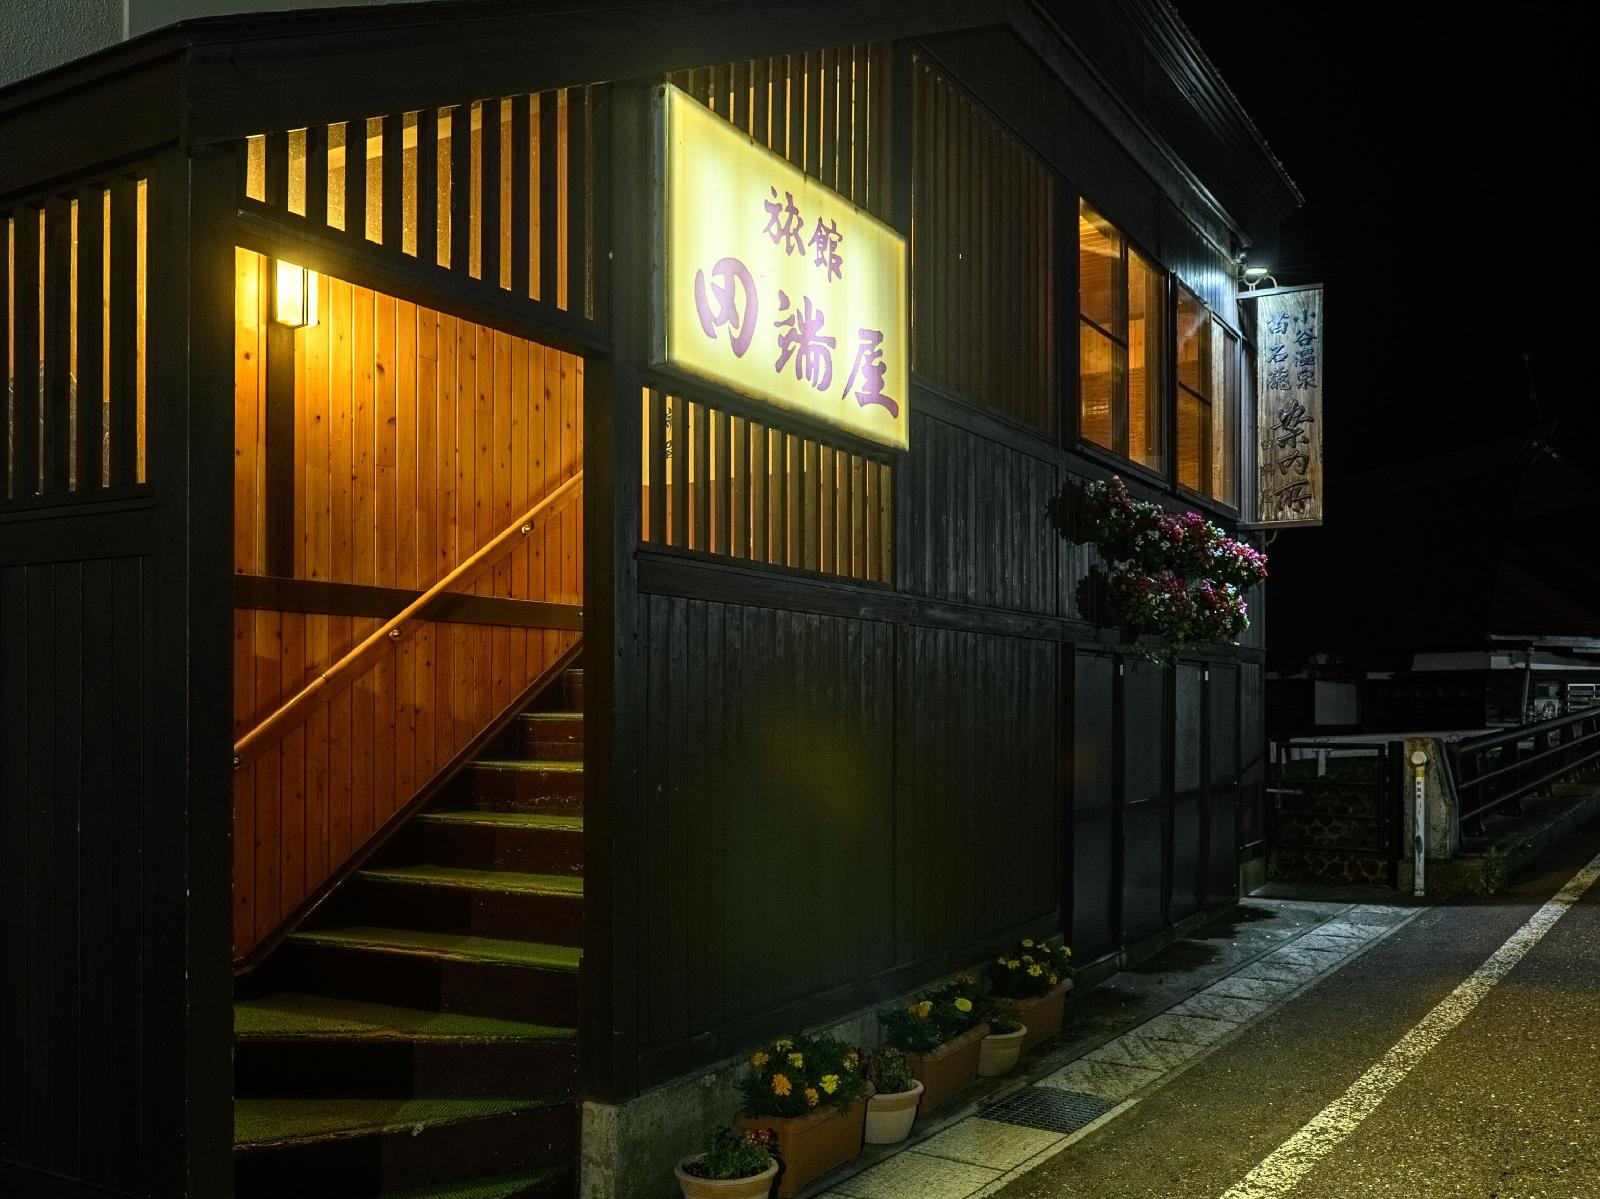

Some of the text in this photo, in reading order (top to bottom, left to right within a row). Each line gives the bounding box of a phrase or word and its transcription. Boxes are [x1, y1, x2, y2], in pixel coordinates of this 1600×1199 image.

[763, 185, 843, 283] 旅館
[694, 257, 899, 419] 田端屋
